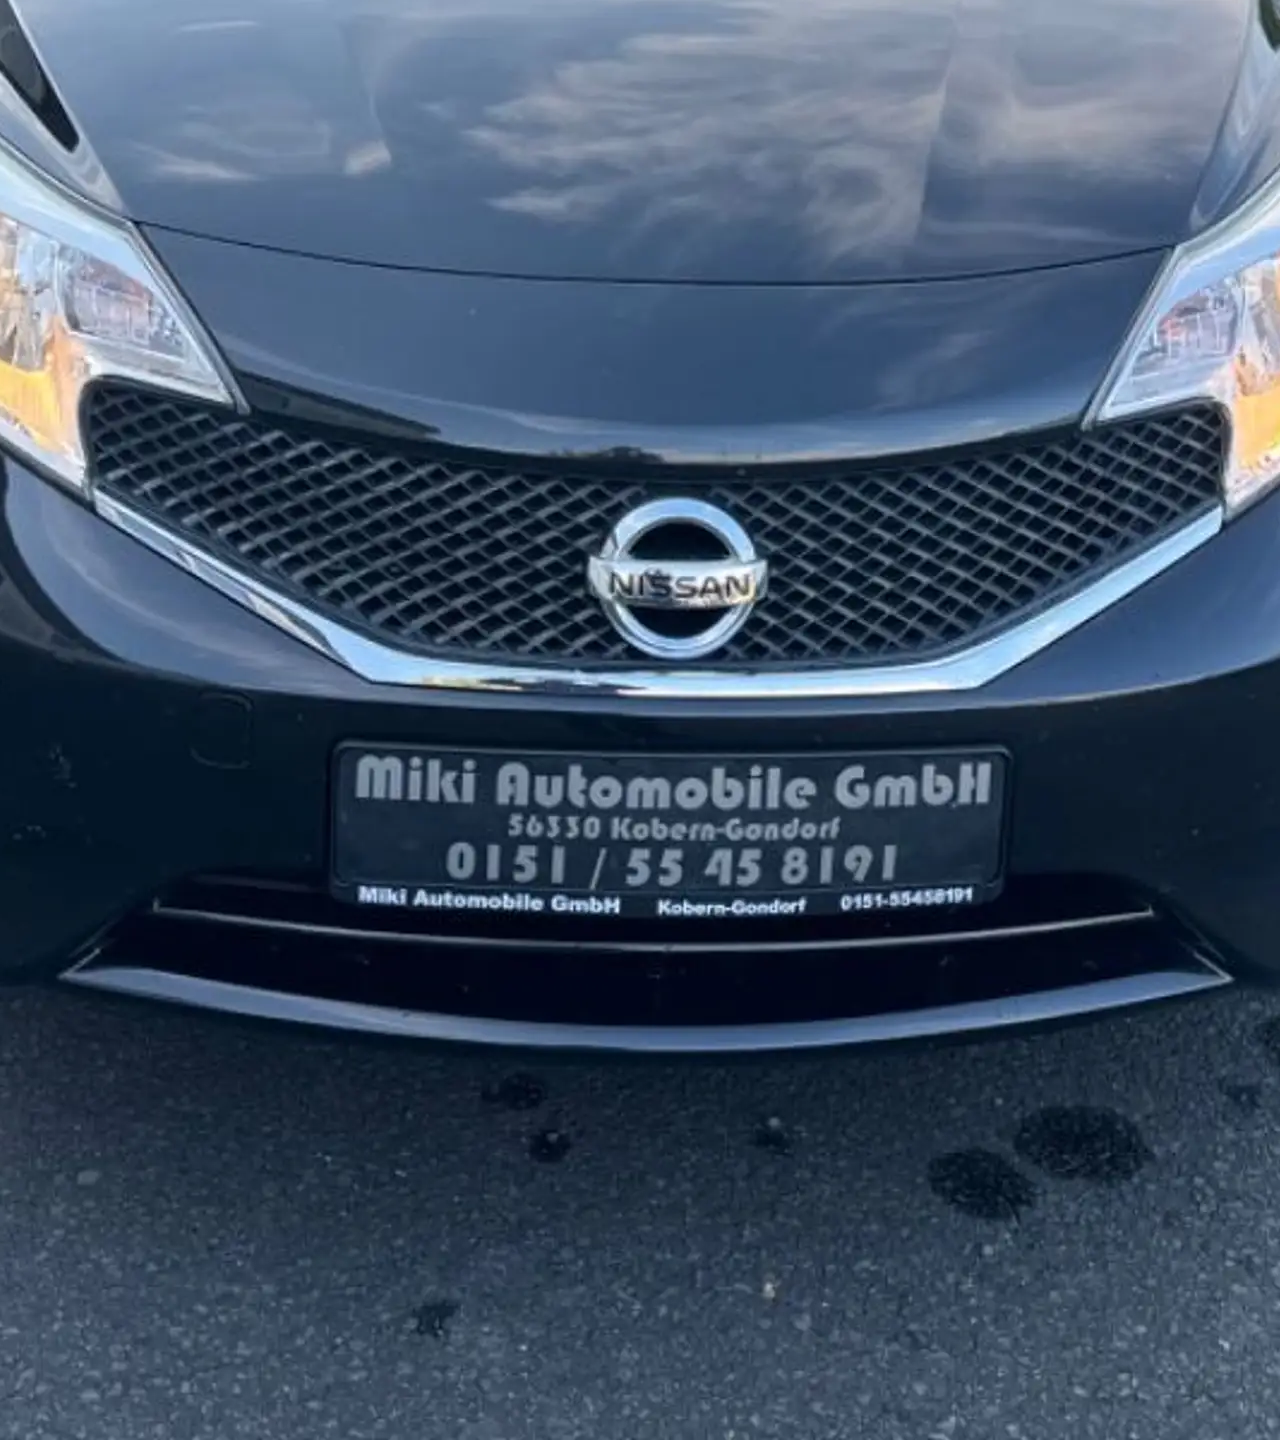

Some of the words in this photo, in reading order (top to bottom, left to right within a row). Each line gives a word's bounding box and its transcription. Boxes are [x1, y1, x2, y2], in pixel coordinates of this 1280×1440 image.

[610, 570, 750, 598] NISSAN
[355, 754, 476, 803] Miki
[496, 761, 817, 811] Automobile
[834, 762, 992, 809] GmbH
[507, 812, 602, 841] 56330
[610, 816, 841, 842] Kobern-Gondorf
[445, 841, 566, 885] 0151
[625, 848, 684, 888] 55
[704, 848, 762, 887] 45
[781, 844, 898, 885] 8191
[357, 885, 407, 906] Miki
[413, 888, 545, 912] Automobile
[550, 895, 621, 915] GmbH
[657, 897, 807, 917] Kobern-Gondorf
